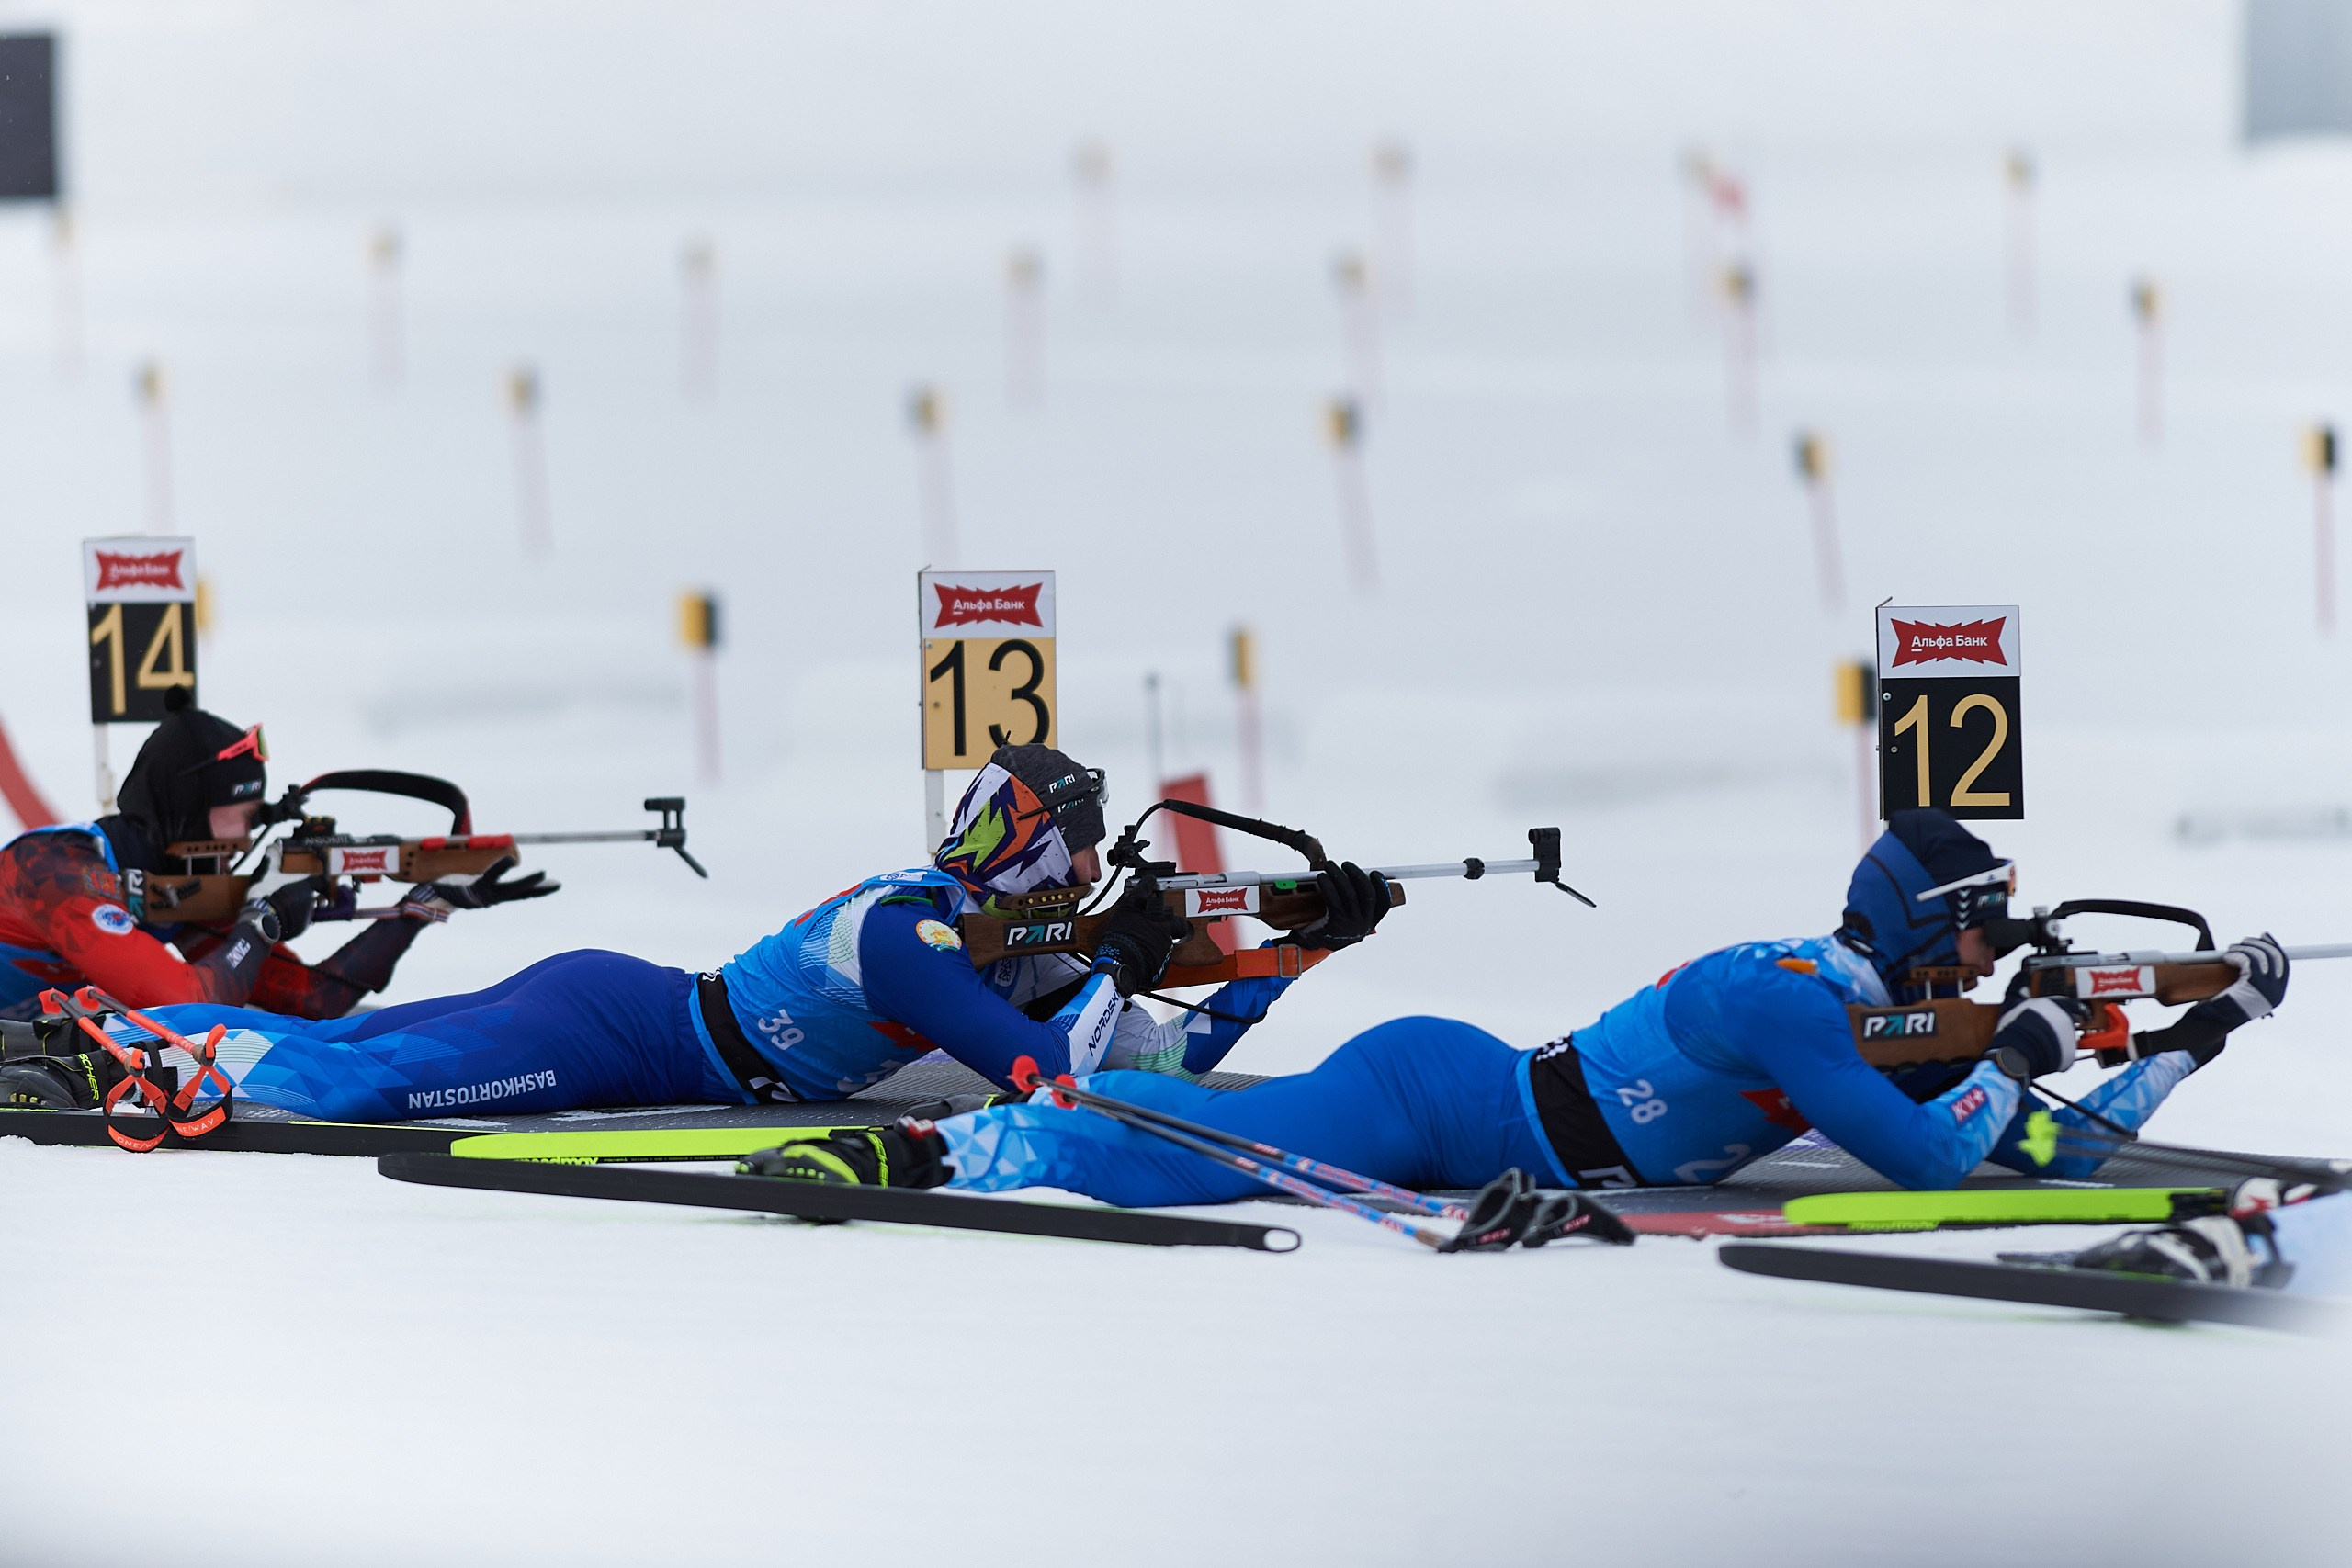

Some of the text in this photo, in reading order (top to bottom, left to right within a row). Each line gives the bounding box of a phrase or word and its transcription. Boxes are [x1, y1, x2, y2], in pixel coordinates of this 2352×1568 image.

[953, 598, 1025, 615] Альфа Банк
[91, 603, 196, 716] 14
[1911, 634, 1988, 652] Альфа Банк
[930, 638, 1050, 756] 13
[1894, 694, 2011, 807] 12
[1048, 773, 1076, 794] PARI
[1007, 921, 1073, 946] PARI
[757, 1009, 805, 1051] 39
[1863, 1011, 1936, 1039] PARI
[77, 1053, 100, 1101] SCHER
[408, 1069, 558, 1109] BASHKORTOSTAN
[1616, 1079, 1668, 1125] 28
[175, 1118, 214, 1134] NE/WAY
